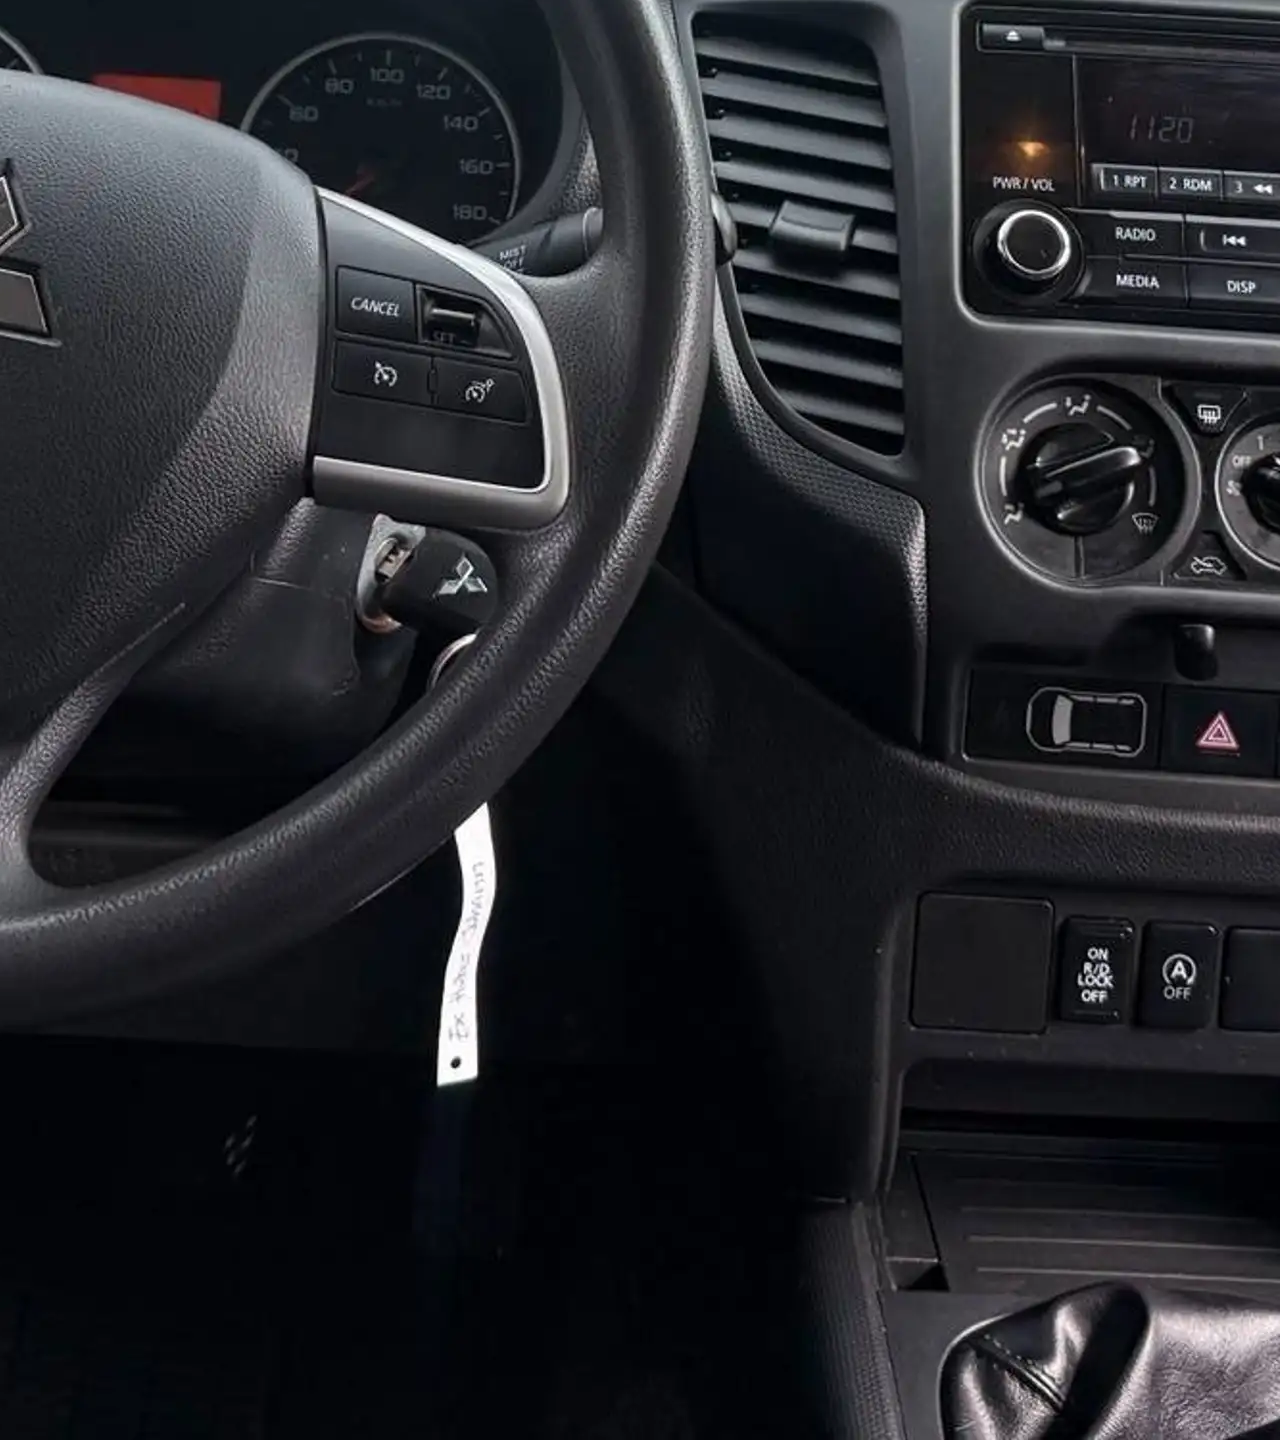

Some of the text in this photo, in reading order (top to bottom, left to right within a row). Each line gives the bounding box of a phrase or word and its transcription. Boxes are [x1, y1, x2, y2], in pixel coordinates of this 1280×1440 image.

[370, 67, 404, 83] 100
[324, 79, 354, 95] 80
[416, 84, 451, 101] 120
[289, 106, 319, 122] 60
[443, 116, 479, 132] 140
[459, 159, 494, 176] 160
[1112, 175, 1147, 189] 1 RPT
[1169, 177, 1212, 191] 2 RDM
[1234, 182, 1244, 195] 3
[453, 205, 487, 221] 180
[1115, 227, 1156, 242] RADIO
[499, 245, 526, 261] MIST
[1116, 274, 1160, 289] MEDIA
[1227, 279, 1256, 294] DISP
[351, 297, 400, 317] CANCEL
[1257, 435, 1264, 451] 1
[1087, 946, 1109, 961] ON
[1083, 962, 1111, 975] R/D
[1170, 960, 1188, 979] A
[1077, 972, 1114, 989] LOCK
[1081, 989, 1108, 1003] OFF
[1163, 985, 1191, 1000] OFF
